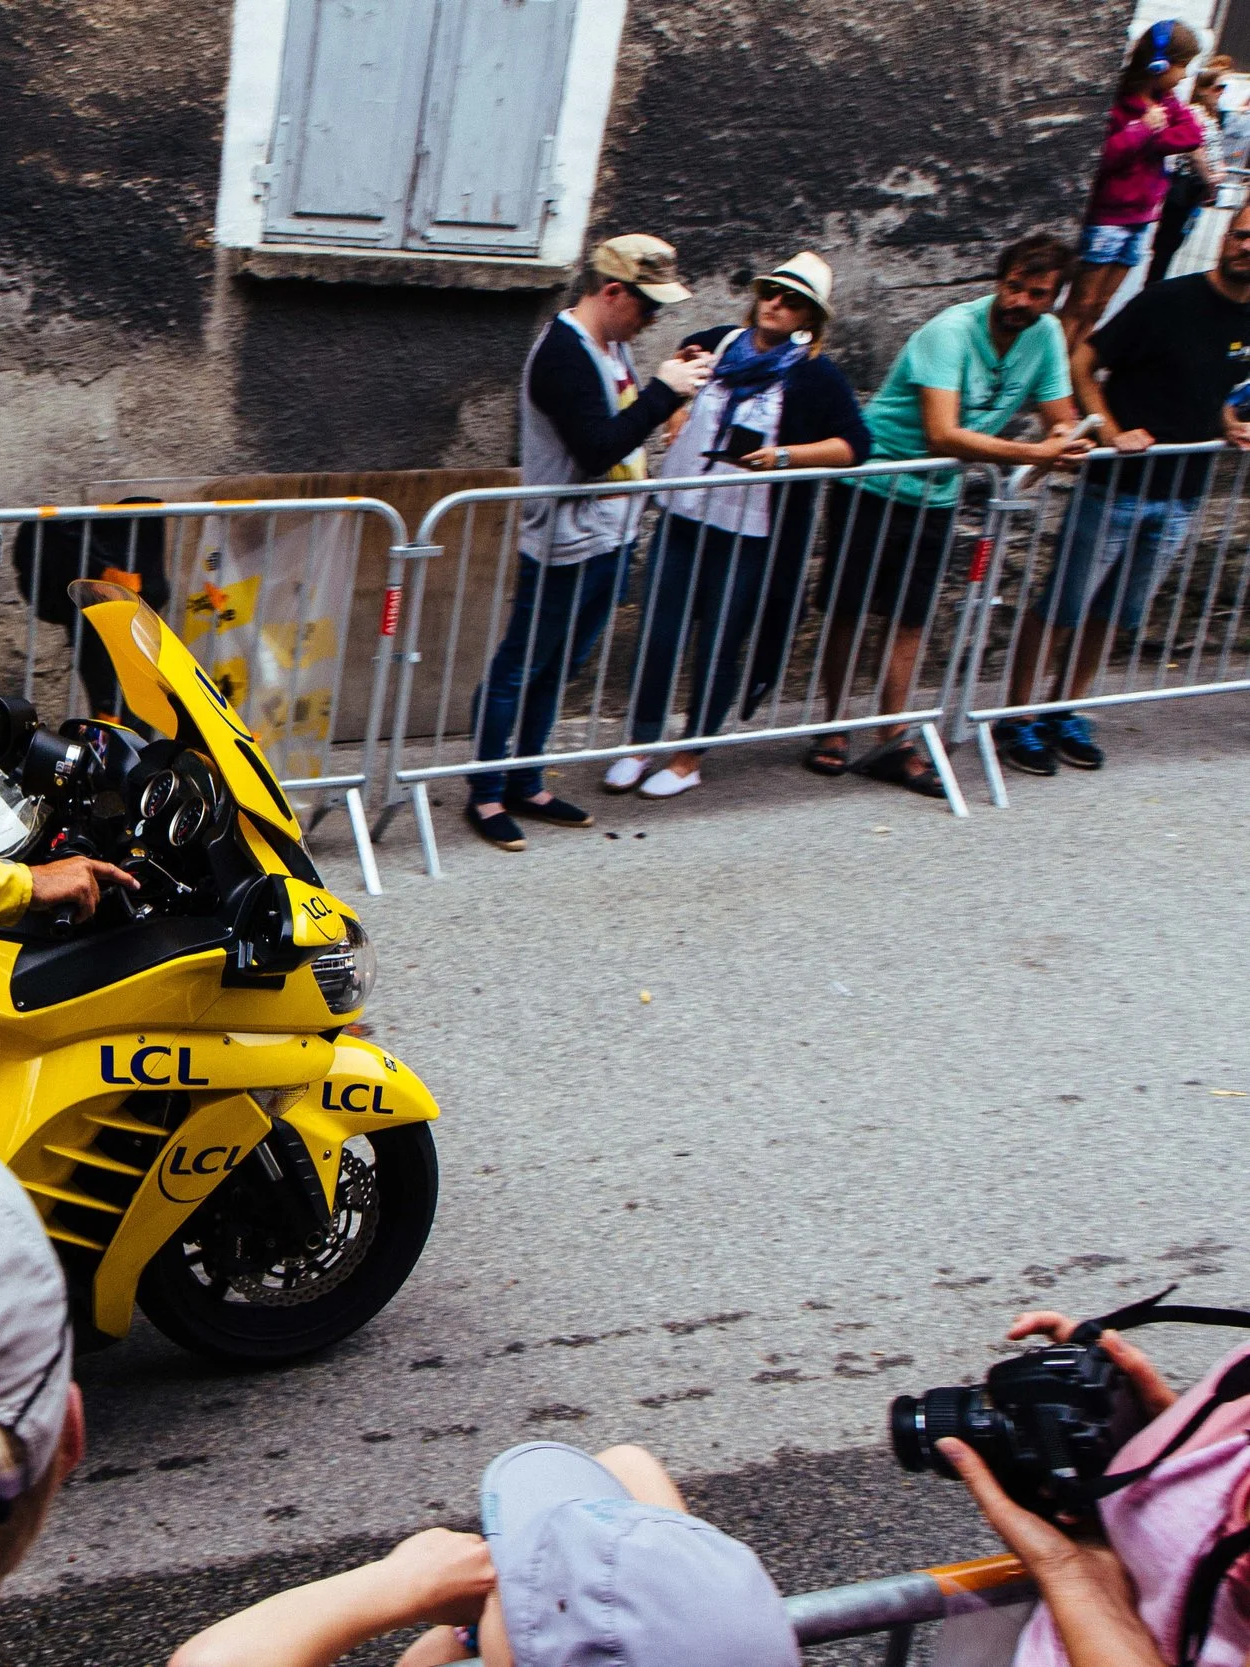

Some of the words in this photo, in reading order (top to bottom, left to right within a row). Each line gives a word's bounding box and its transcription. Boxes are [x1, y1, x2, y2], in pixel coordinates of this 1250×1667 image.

[301, 895, 333, 920] LCL
[100, 1045, 209, 1086] LCL
[322, 1081, 394, 1115] LCL
[170, 1145, 241, 1175] LCL
